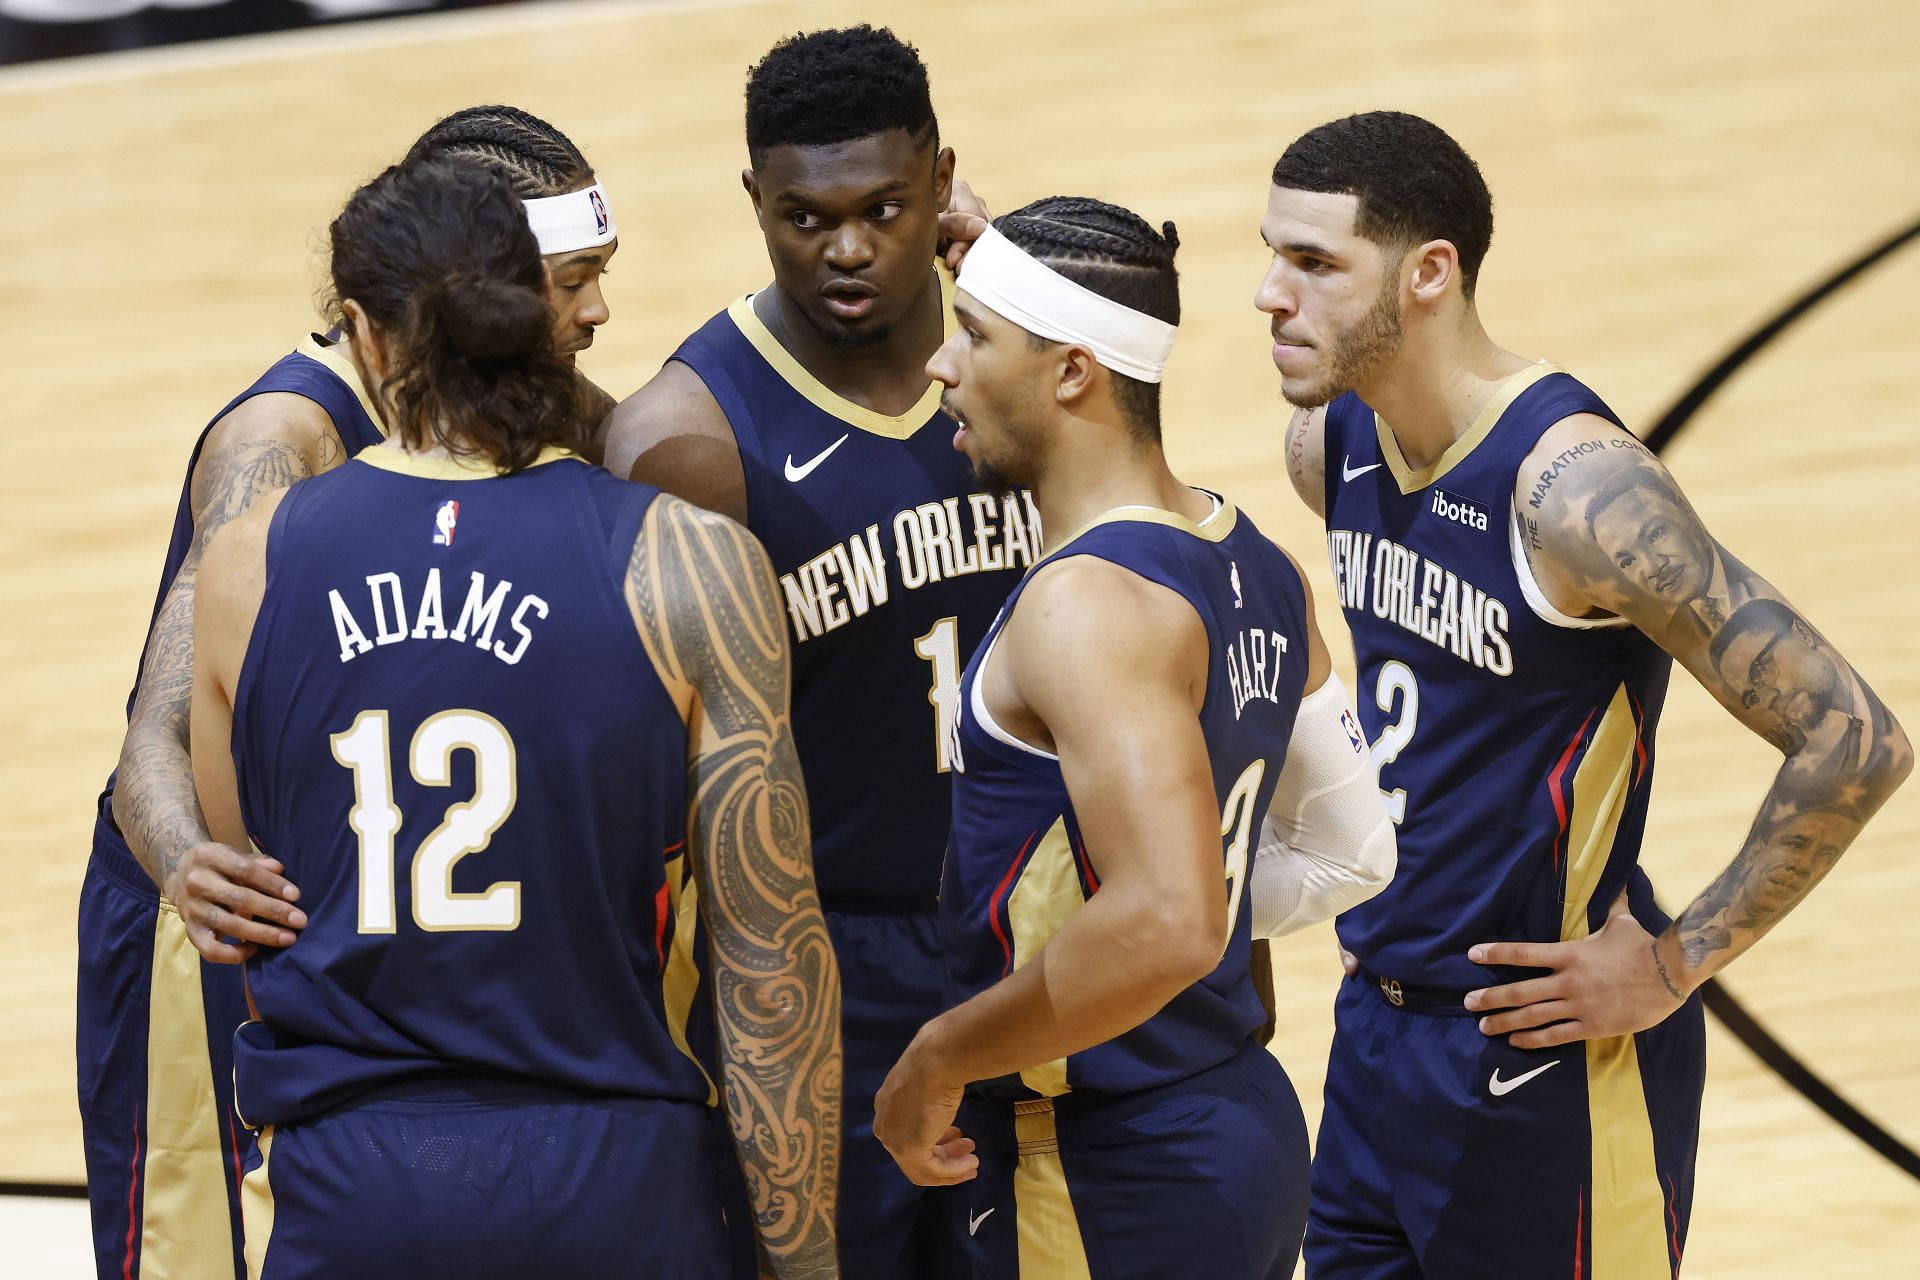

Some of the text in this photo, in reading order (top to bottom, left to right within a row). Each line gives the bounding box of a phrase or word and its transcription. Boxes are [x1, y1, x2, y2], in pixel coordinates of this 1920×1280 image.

[1431, 489, 1488, 531] ibotta
[1529, 440, 1606, 508] MARATHON
[779, 523, 889, 643] NEW
[1526, 517, 1542, 551] THE
[328, 568, 549, 665] ADAMS
[1373, 538, 1514, 677] ORLEANS
[913, 616, 961, 774] 1
[1226, 628, 1288, 722] HART
[1369, 659, 1419, 824] 2
[329, 708, 521, 935] 12
